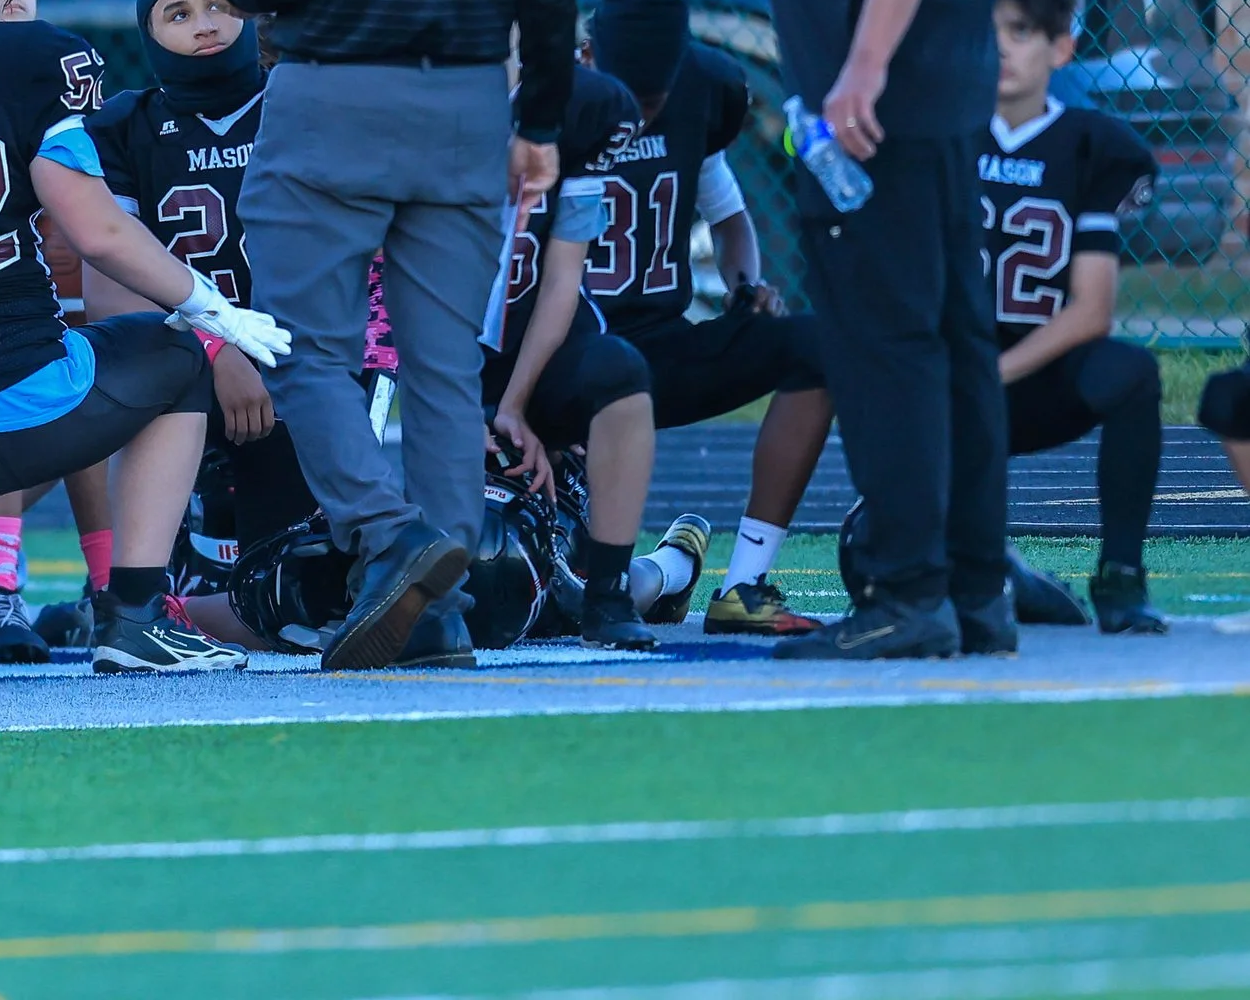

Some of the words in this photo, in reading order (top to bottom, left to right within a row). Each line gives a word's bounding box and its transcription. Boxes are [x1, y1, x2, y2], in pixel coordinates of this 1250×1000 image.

[158, 184, 252, 302] 2
[581, 170, 678, 297] 31
[979, 196, 1073, 324] 2
